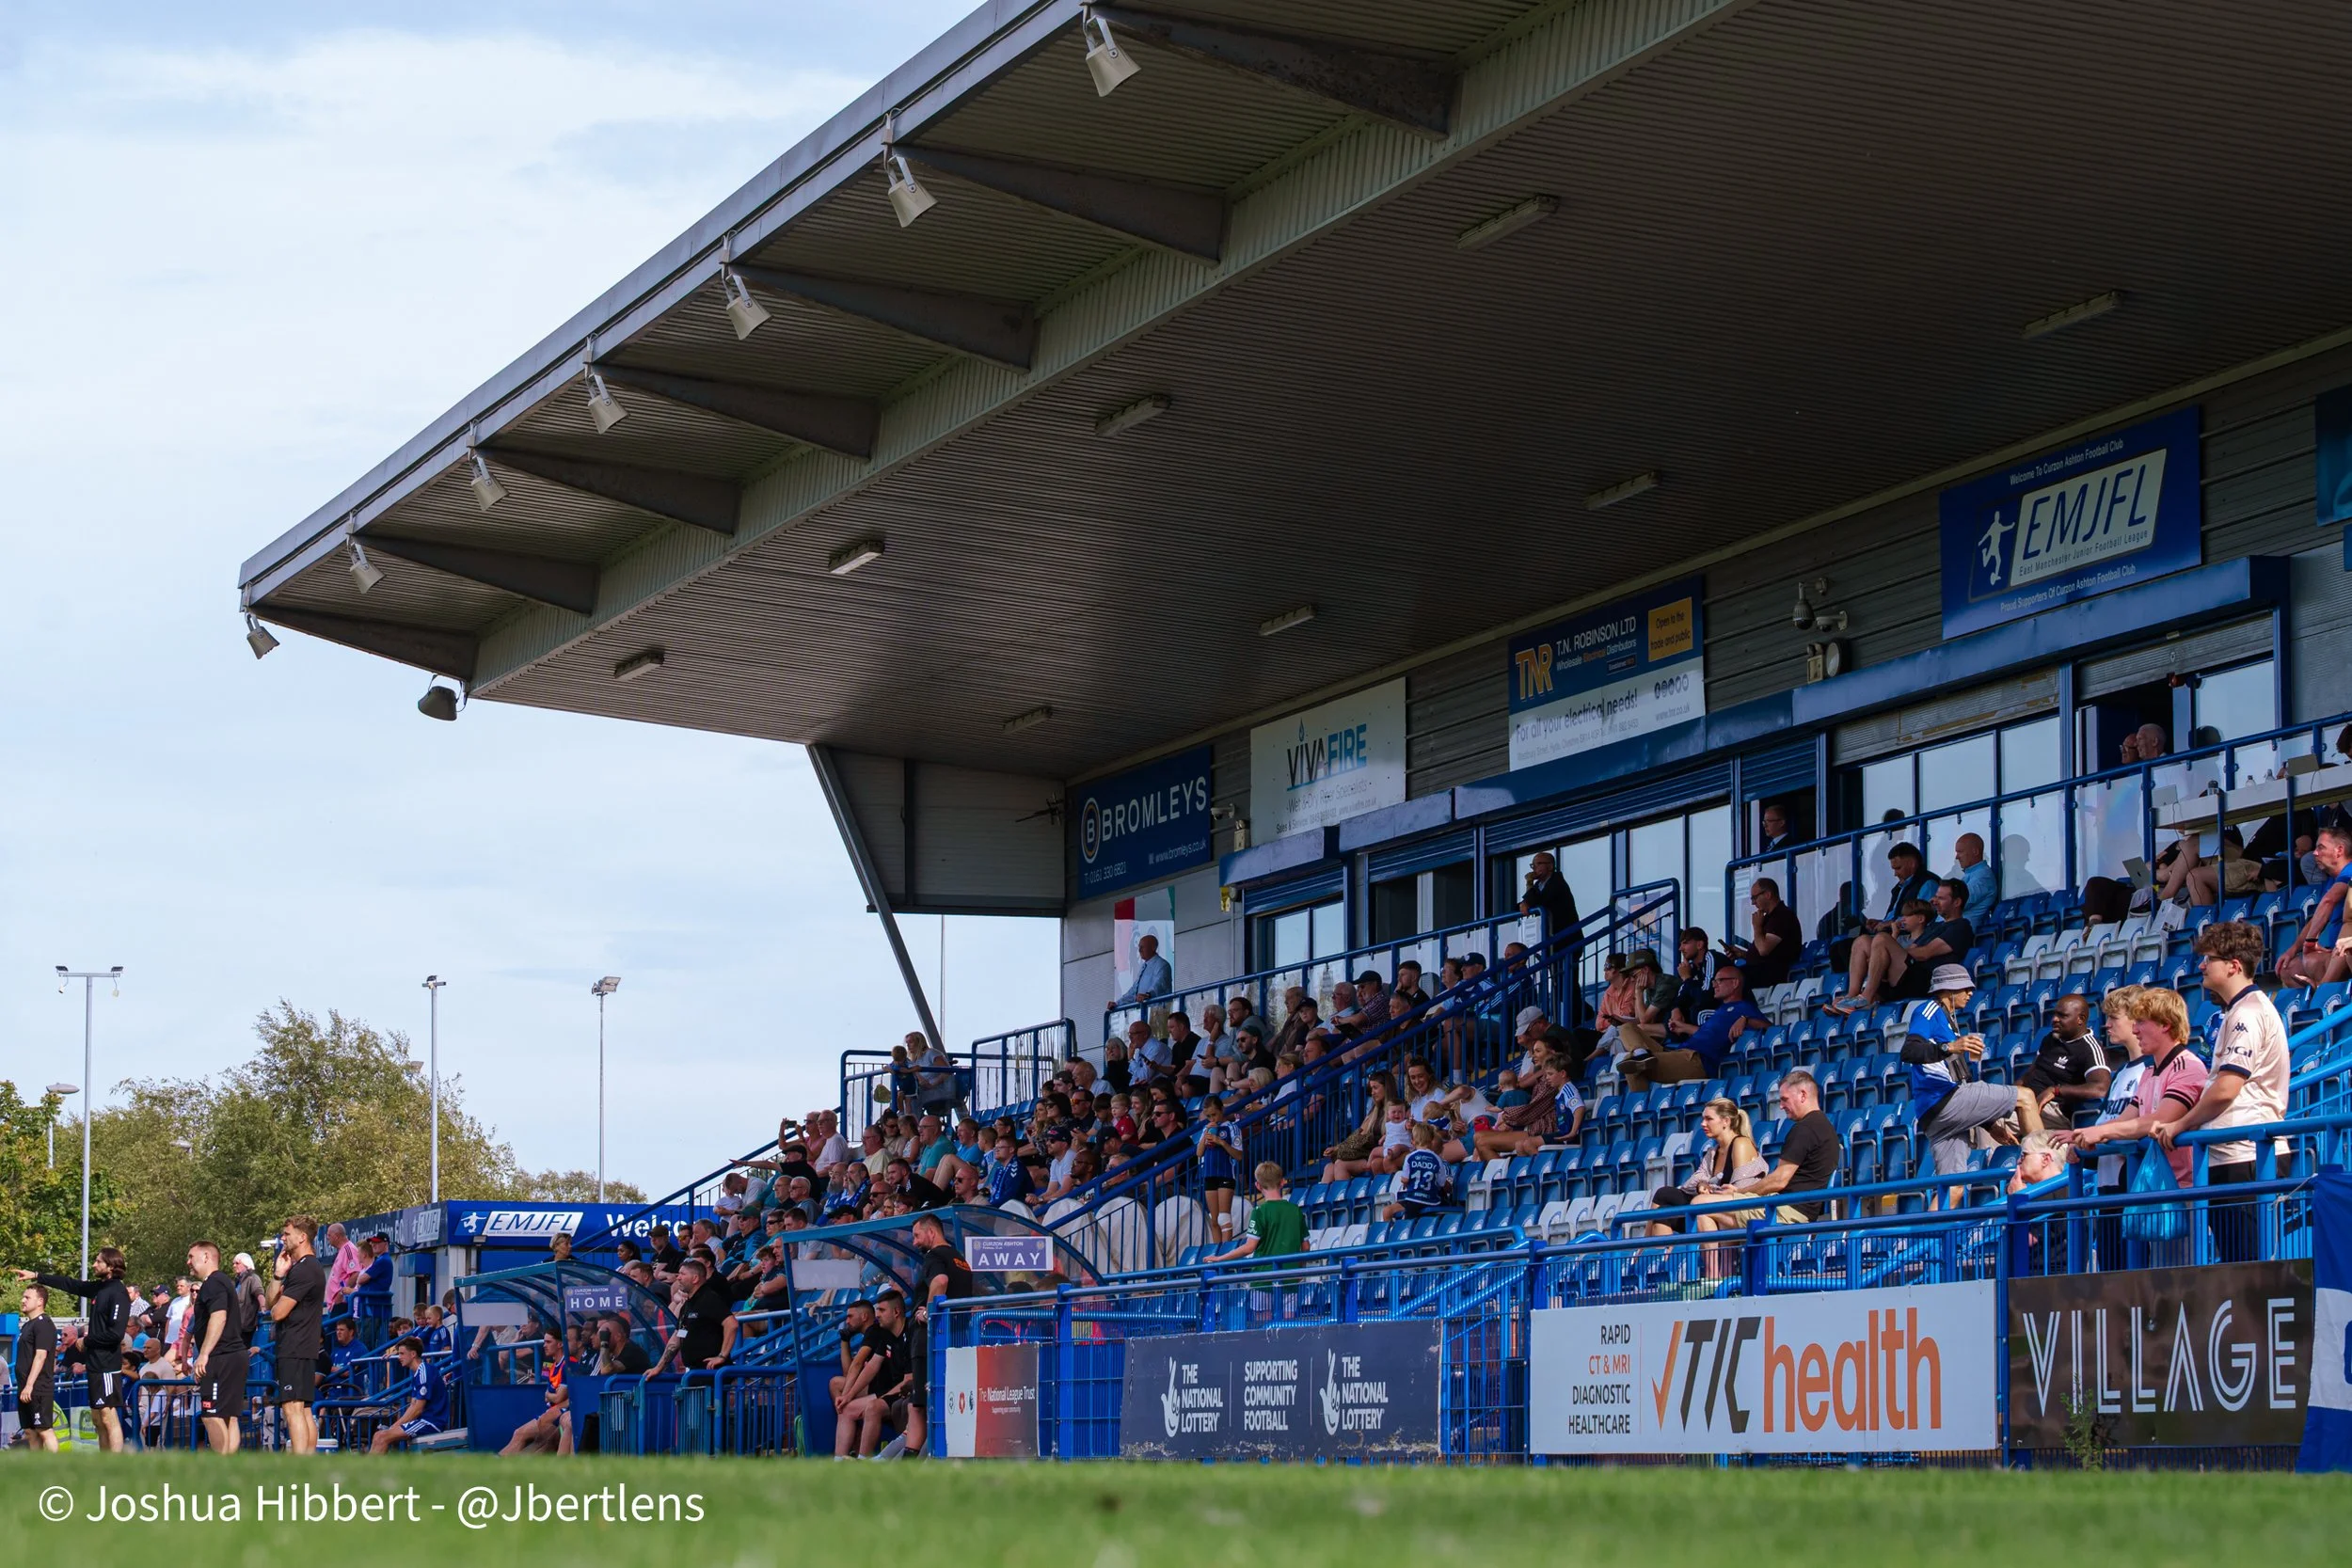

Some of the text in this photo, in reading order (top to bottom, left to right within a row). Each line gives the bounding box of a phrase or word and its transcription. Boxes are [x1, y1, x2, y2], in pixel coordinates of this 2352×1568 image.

[2010, 437, 2123, 486] Welcome To Curzon Ashton Football Club
[2023, 464, 2147, 560] EMJFL
[2019, 529, 2149, 577] East Manchester Junior Football League
[2000, 563, 2137, 613] Proud Supporters Of Curzon Ashton Football Club
[1656, 610, 1686, 631] Open to the
[1556, 638, 1572, 657] T.N.
[1573, 621, 1619, 652] ROBINSON
[1620, 615, 1637, 637] LTD
[1650, 628, 1692, 650] trade and public
[1556, 655, 1582, 673] Wholesale
[1606, 638, 1637, 657] Distributors
[1515, 642, 1554, 701] TNR
[1516, 687, 1639, 744] For all your electrical needs!
[1102, 776, 1207, 842] BROMLEYS
[1087, 818, 1095, 843] B
[1155, 838, 1207, 863] www.bromleys.co.uk
[1411, 1170, 1434, 1191] 13
[489, 1213, 573, 1231] EMJFL
[977, 1252, 1041, 1267] AWAY
[570, 1295, 624, 1309] HOME
[1600, 1323, 1631, 1346] RAPID
[1342, 1355, 1361, 1378] THE
[1588, 1354, 1630, 1375] CT & MRI
[2023, 1297, 2297, 1418] VILLAGE
[1182, 1363, 1200, 1385] THE
[1244, 1359, 1298, 1383] SUPPORTING
[978, 1385, 1036, 1404] The National League Trust
[1182, 1387, 1224, 1409] NATIONAL
[1244, 1385, 1297, 1407] COMMUNITY
[1342, 1381, 1390, 1404] NATIONAL
[1572, 1384, 1631, 1405] DIAGNOSTIC
[1181, 1412, 1219, 1433] LOTTERY
[1244, 1410, 1289, 1431] FOOTBALL
[1342, 1408, 1384, 1431] LOTTERY
[1568, 1414, 1631, 1434] HEALTHCARE
